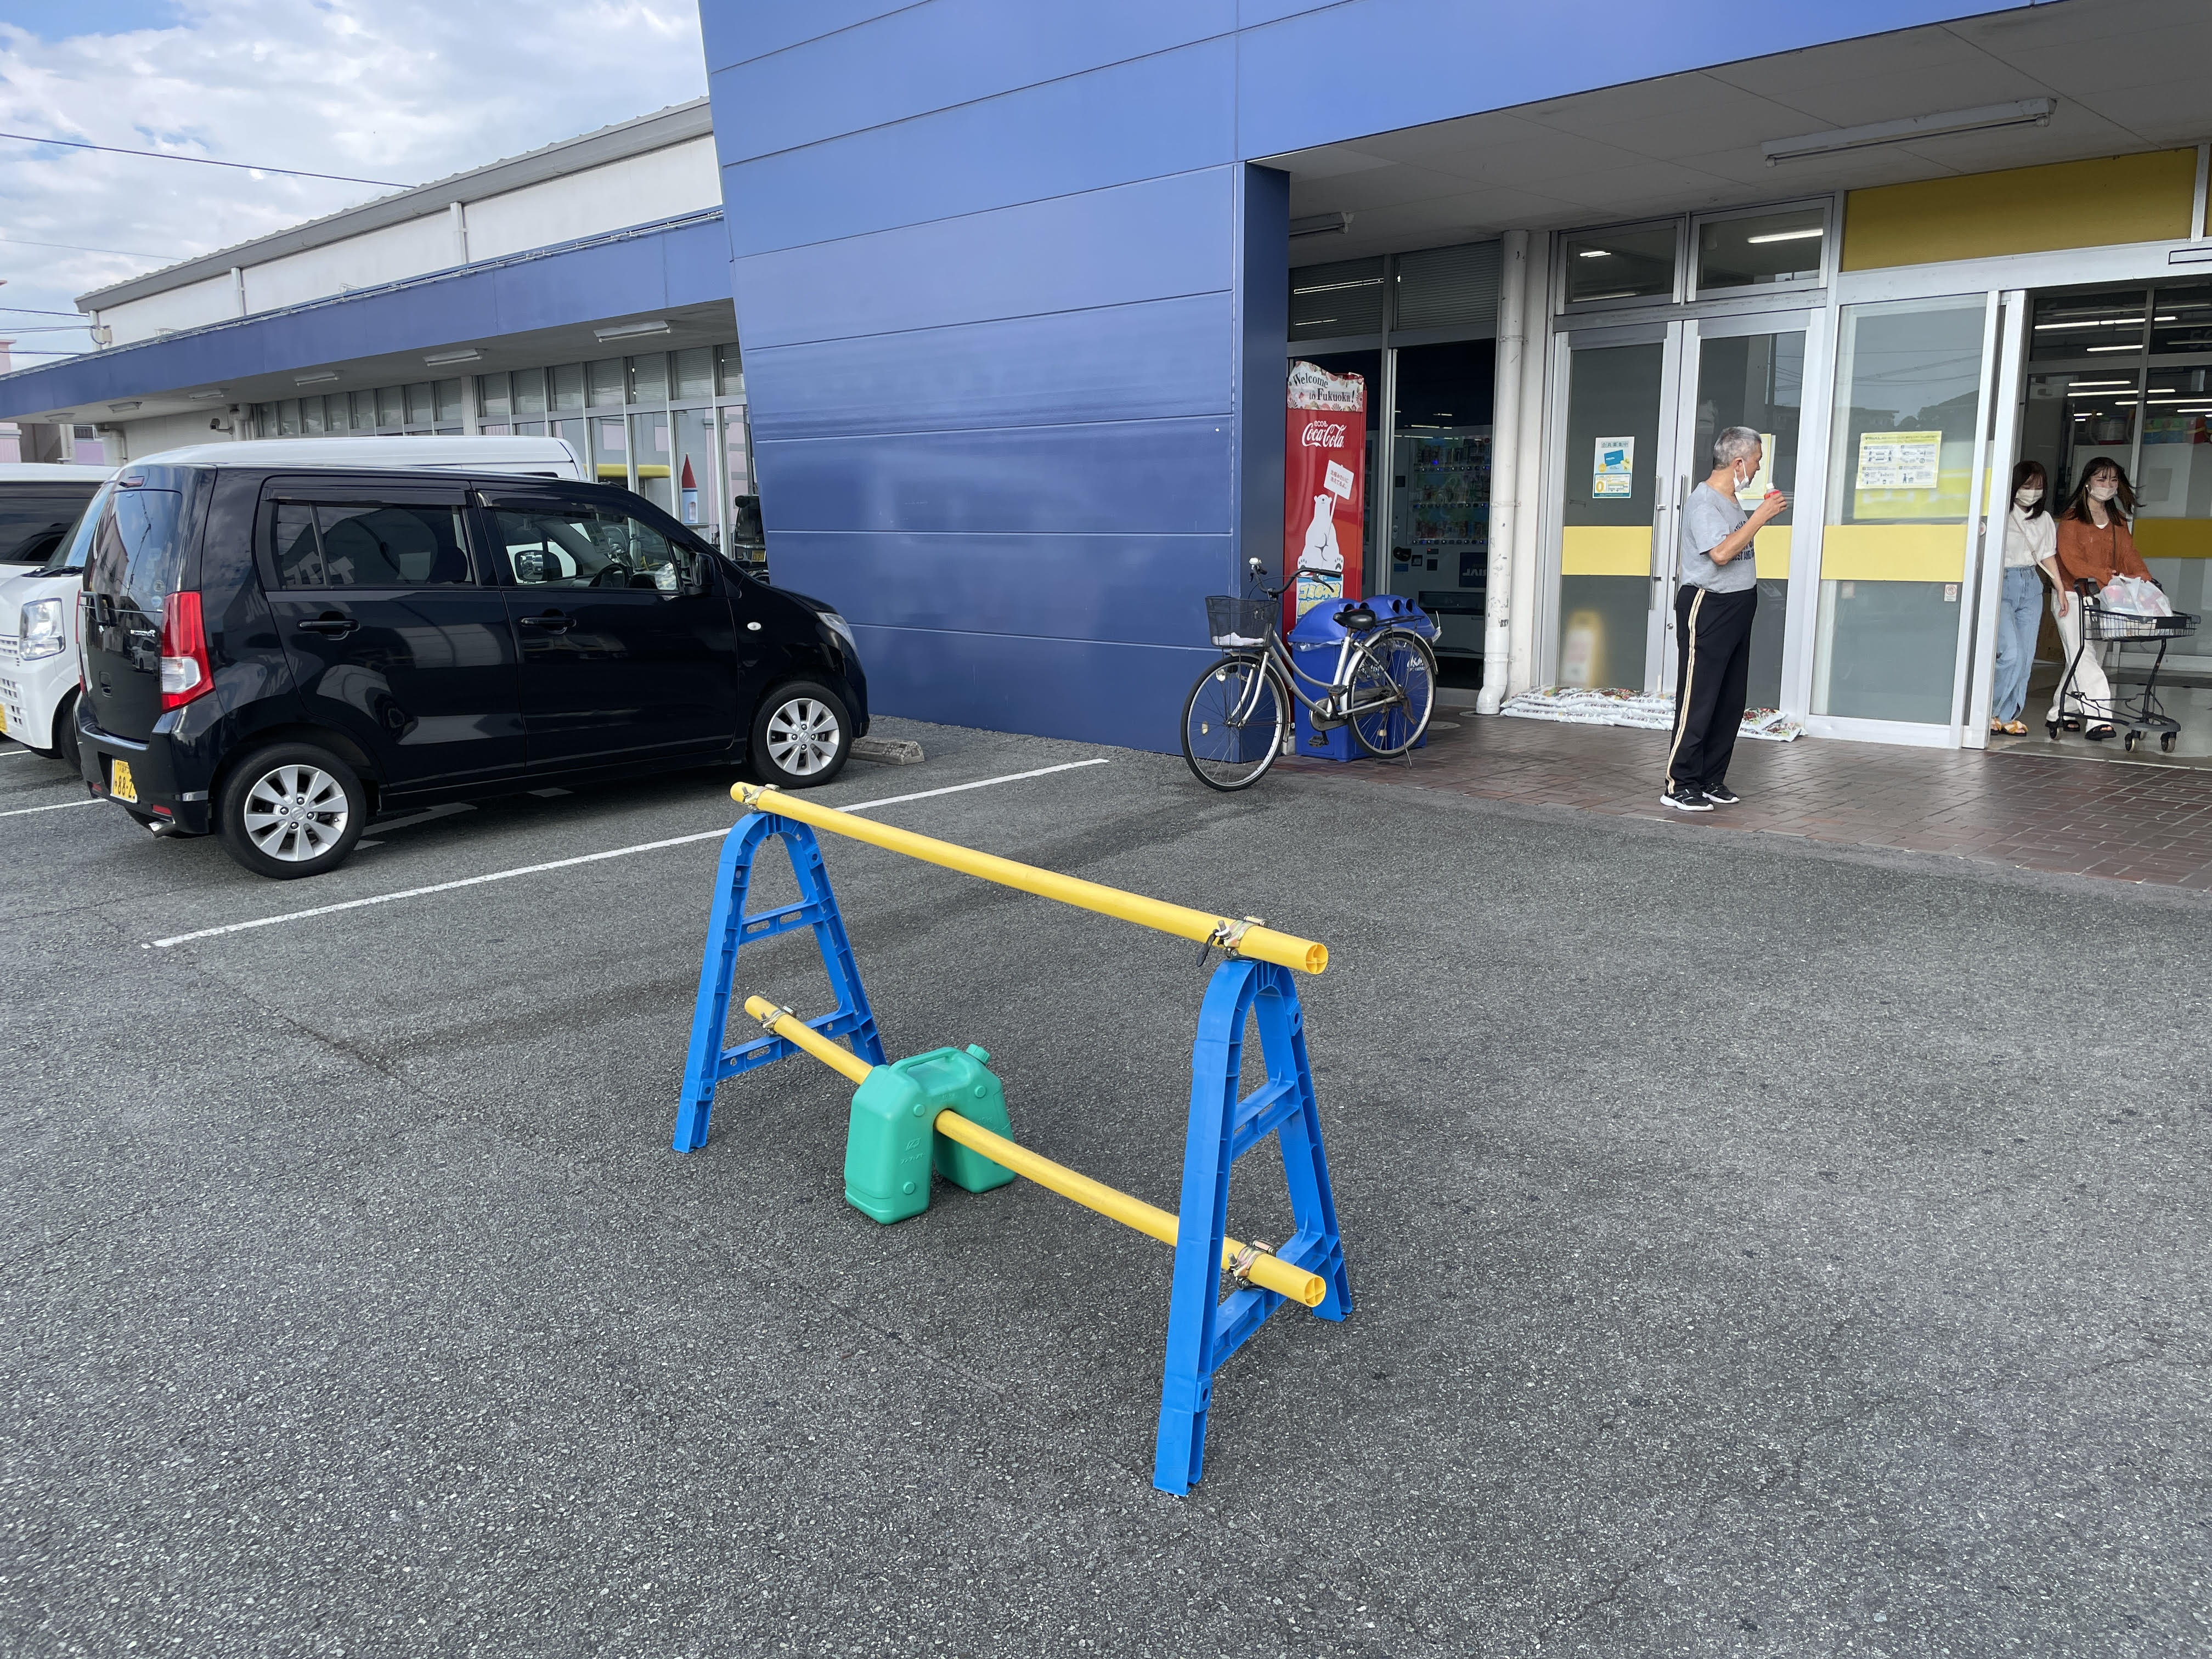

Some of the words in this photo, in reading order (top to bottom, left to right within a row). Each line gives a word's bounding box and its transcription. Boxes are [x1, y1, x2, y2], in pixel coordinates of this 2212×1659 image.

[1293, 373, 1328, 388] Welcome
[1317, 388, 1355, 403] Fukuoka!
[1302, 422, 1347, 448] Coca-Cola
